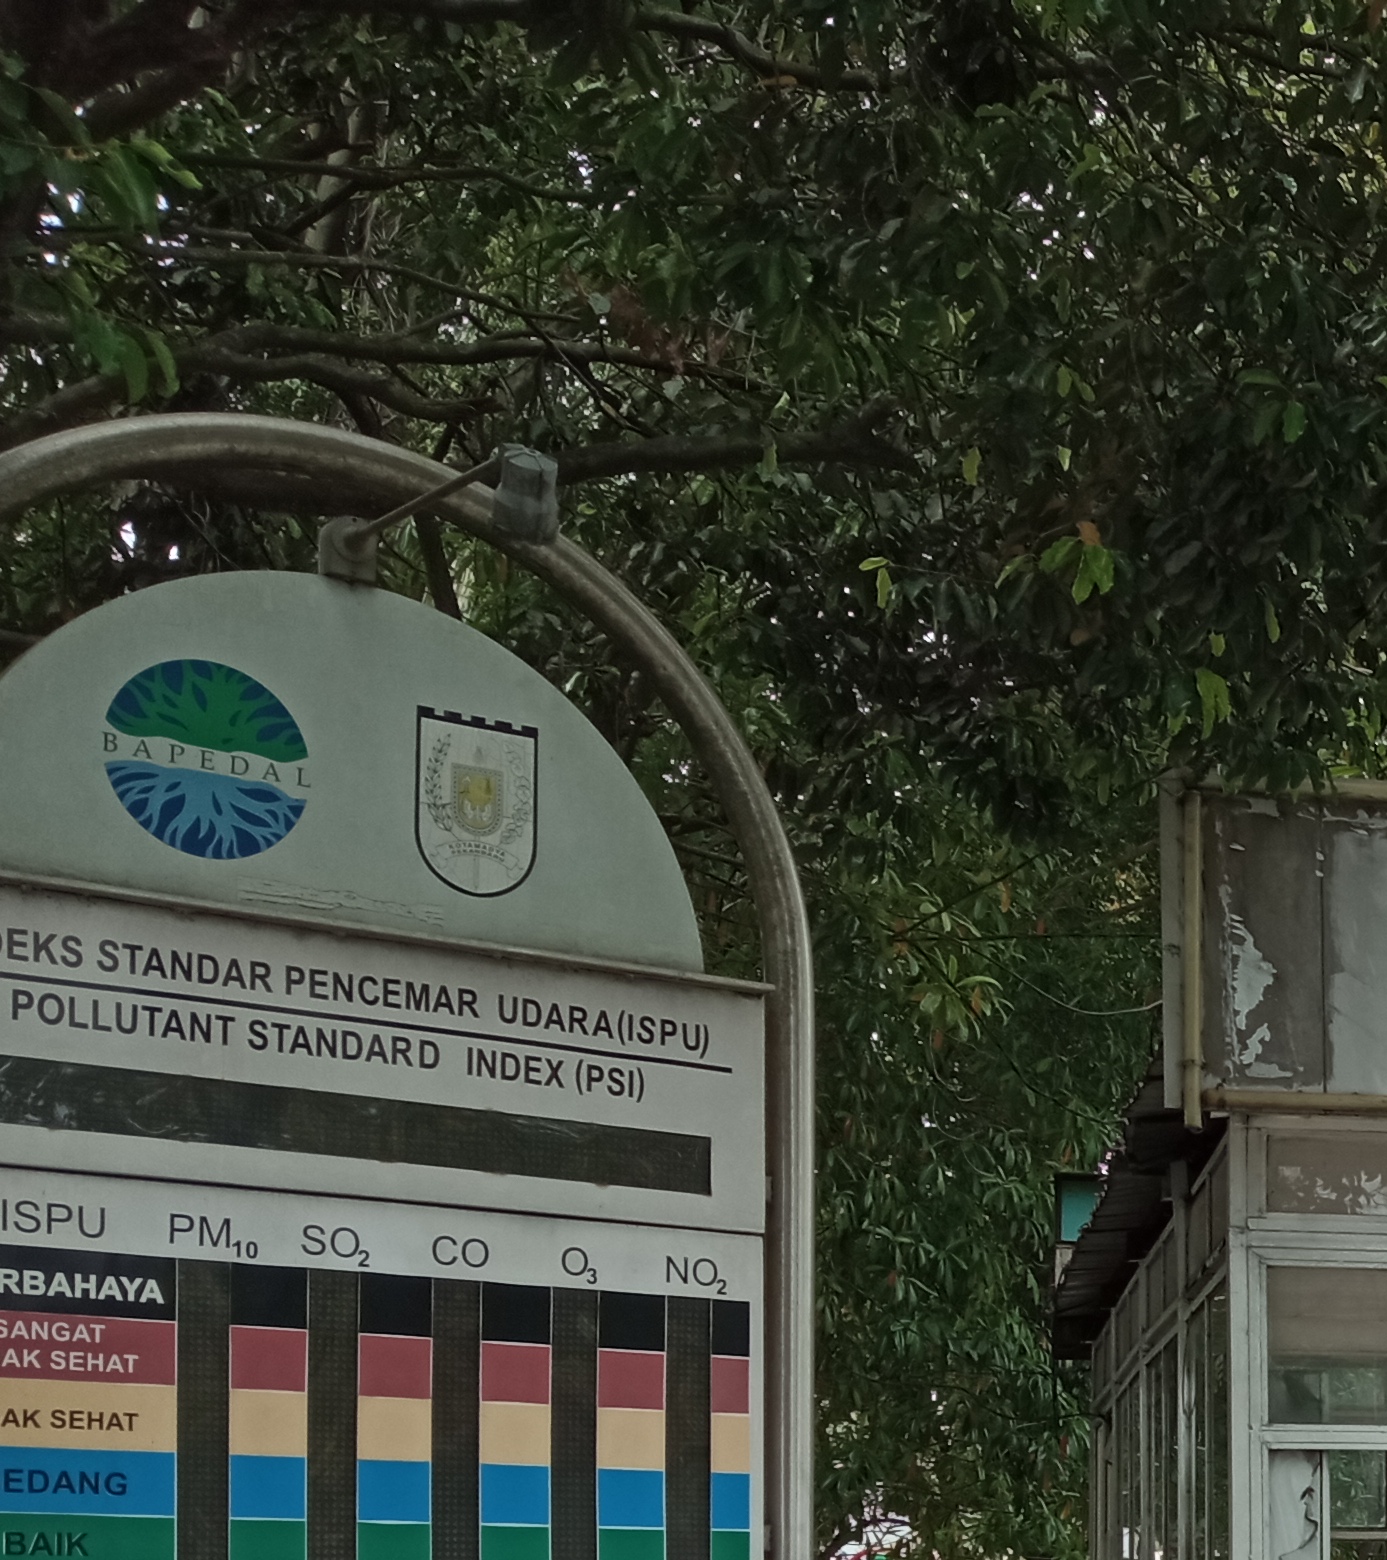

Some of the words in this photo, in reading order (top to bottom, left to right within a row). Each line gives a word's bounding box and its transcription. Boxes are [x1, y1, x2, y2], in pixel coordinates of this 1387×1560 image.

[102, 731, 311, 788] BAPEDAL
[0, 927, 84, 969] EKS
[96, 938, 273, 993] STANDAR
[285, 965, 480, 1019] PENCEMAR
[11, 988, 236, 1046] POLLUTANT
[247, 1019, 441, 1070] STANDARD
[466, 1047, 566, 1089] INDEX
[575, 1059, 645, 1103] (PSI)
[1, 1200, 106, 1239] ISPU
[431, 1235, 489, 1268] CO
[50, 1350, 139, 1374] SEHAT
[50, 1409, 139, 1432] SEHAT
[3, 1468, 128, 1496] EDANG
[3, 1531, 89, 1557] BAIK
